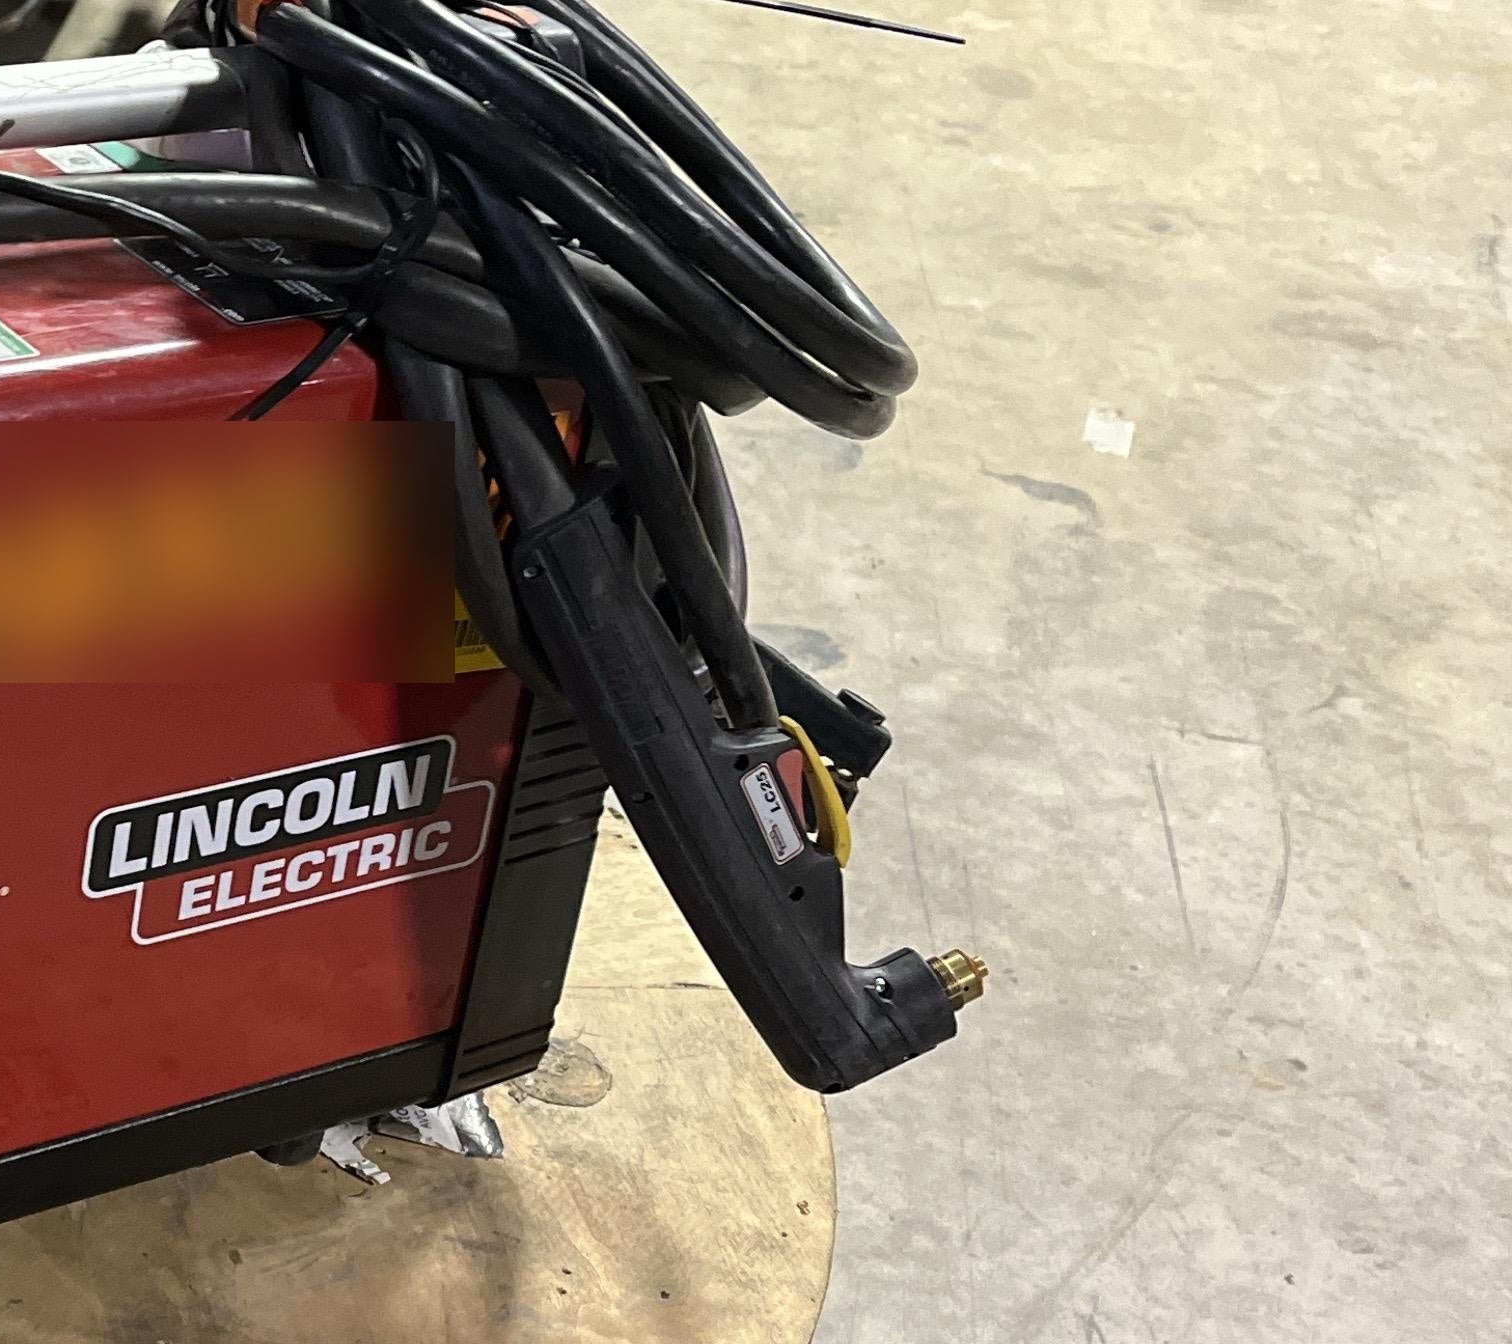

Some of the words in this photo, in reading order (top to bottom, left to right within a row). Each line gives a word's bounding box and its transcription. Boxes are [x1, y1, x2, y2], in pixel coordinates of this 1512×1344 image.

[108, 755, 432, 878] LINCOLN
[756, 771, 782, 813] LC25
[178, 820, 452, 921] ELECTRIC
